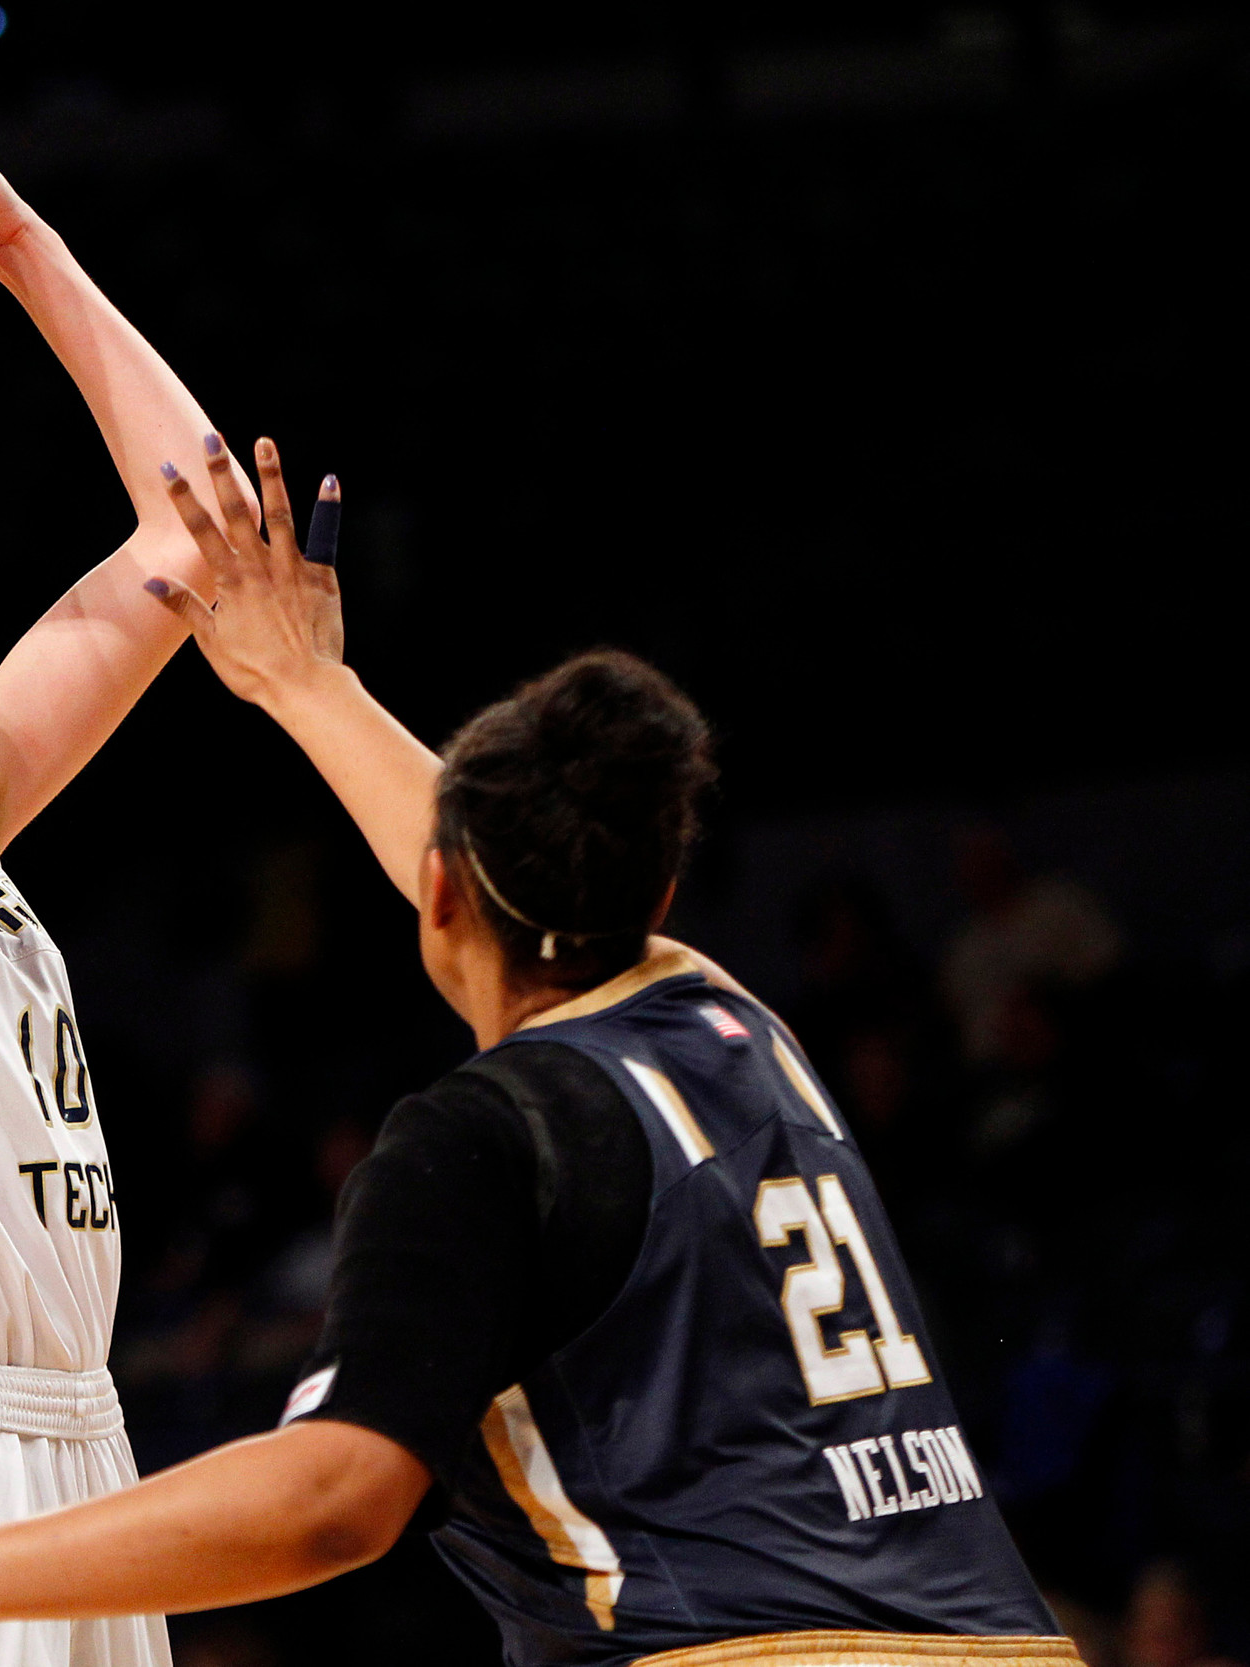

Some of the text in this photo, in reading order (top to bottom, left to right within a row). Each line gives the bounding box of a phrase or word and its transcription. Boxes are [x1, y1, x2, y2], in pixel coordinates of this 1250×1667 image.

[17, 1003, 92, 1130] 10
[753, 1173, 934, 1408] 21
[822, 1425, 984, 1522] NELSON
